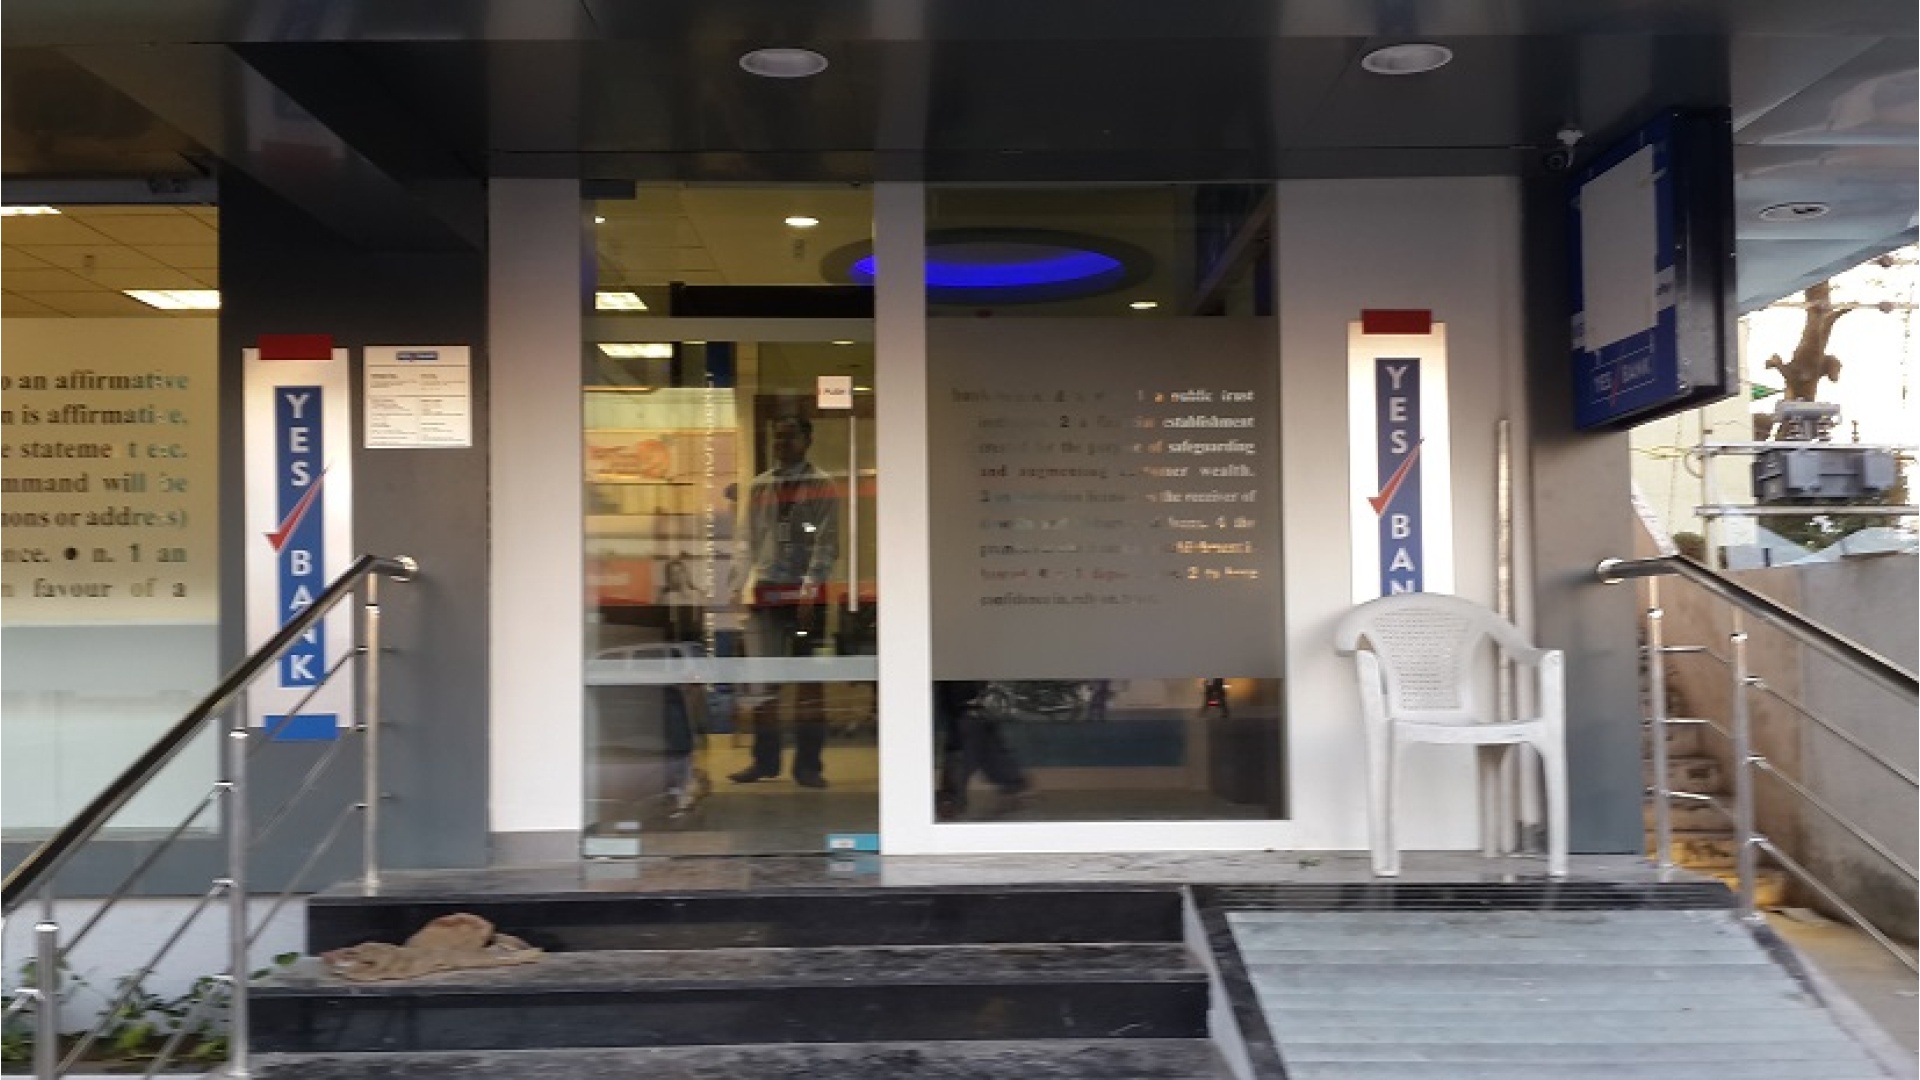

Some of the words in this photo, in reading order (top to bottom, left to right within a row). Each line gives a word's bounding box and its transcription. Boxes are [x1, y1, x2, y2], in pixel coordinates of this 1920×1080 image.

[18, 375, 48, 390] an
[55, 369, 189, 390] affirmative
[21, 403, 41, 424] is
[1385, 365, 1410, 454] YES
[1162, 416, 1255, 428] establishment
[285, 392, 312, 486] YES
[1168, 439, 1256, 455] safeguarding
[20, 441, 137, 458] statemet
[103, 472, 146, 493] will
[54, 512, 82, 527] or
[156, 548, 188, 562] an
[1389, 514, 1416, 596] BAN
[33, 577, 114, 597] favour
[130, 577, 158, 597] of
[173, 583, 187, 597] a
